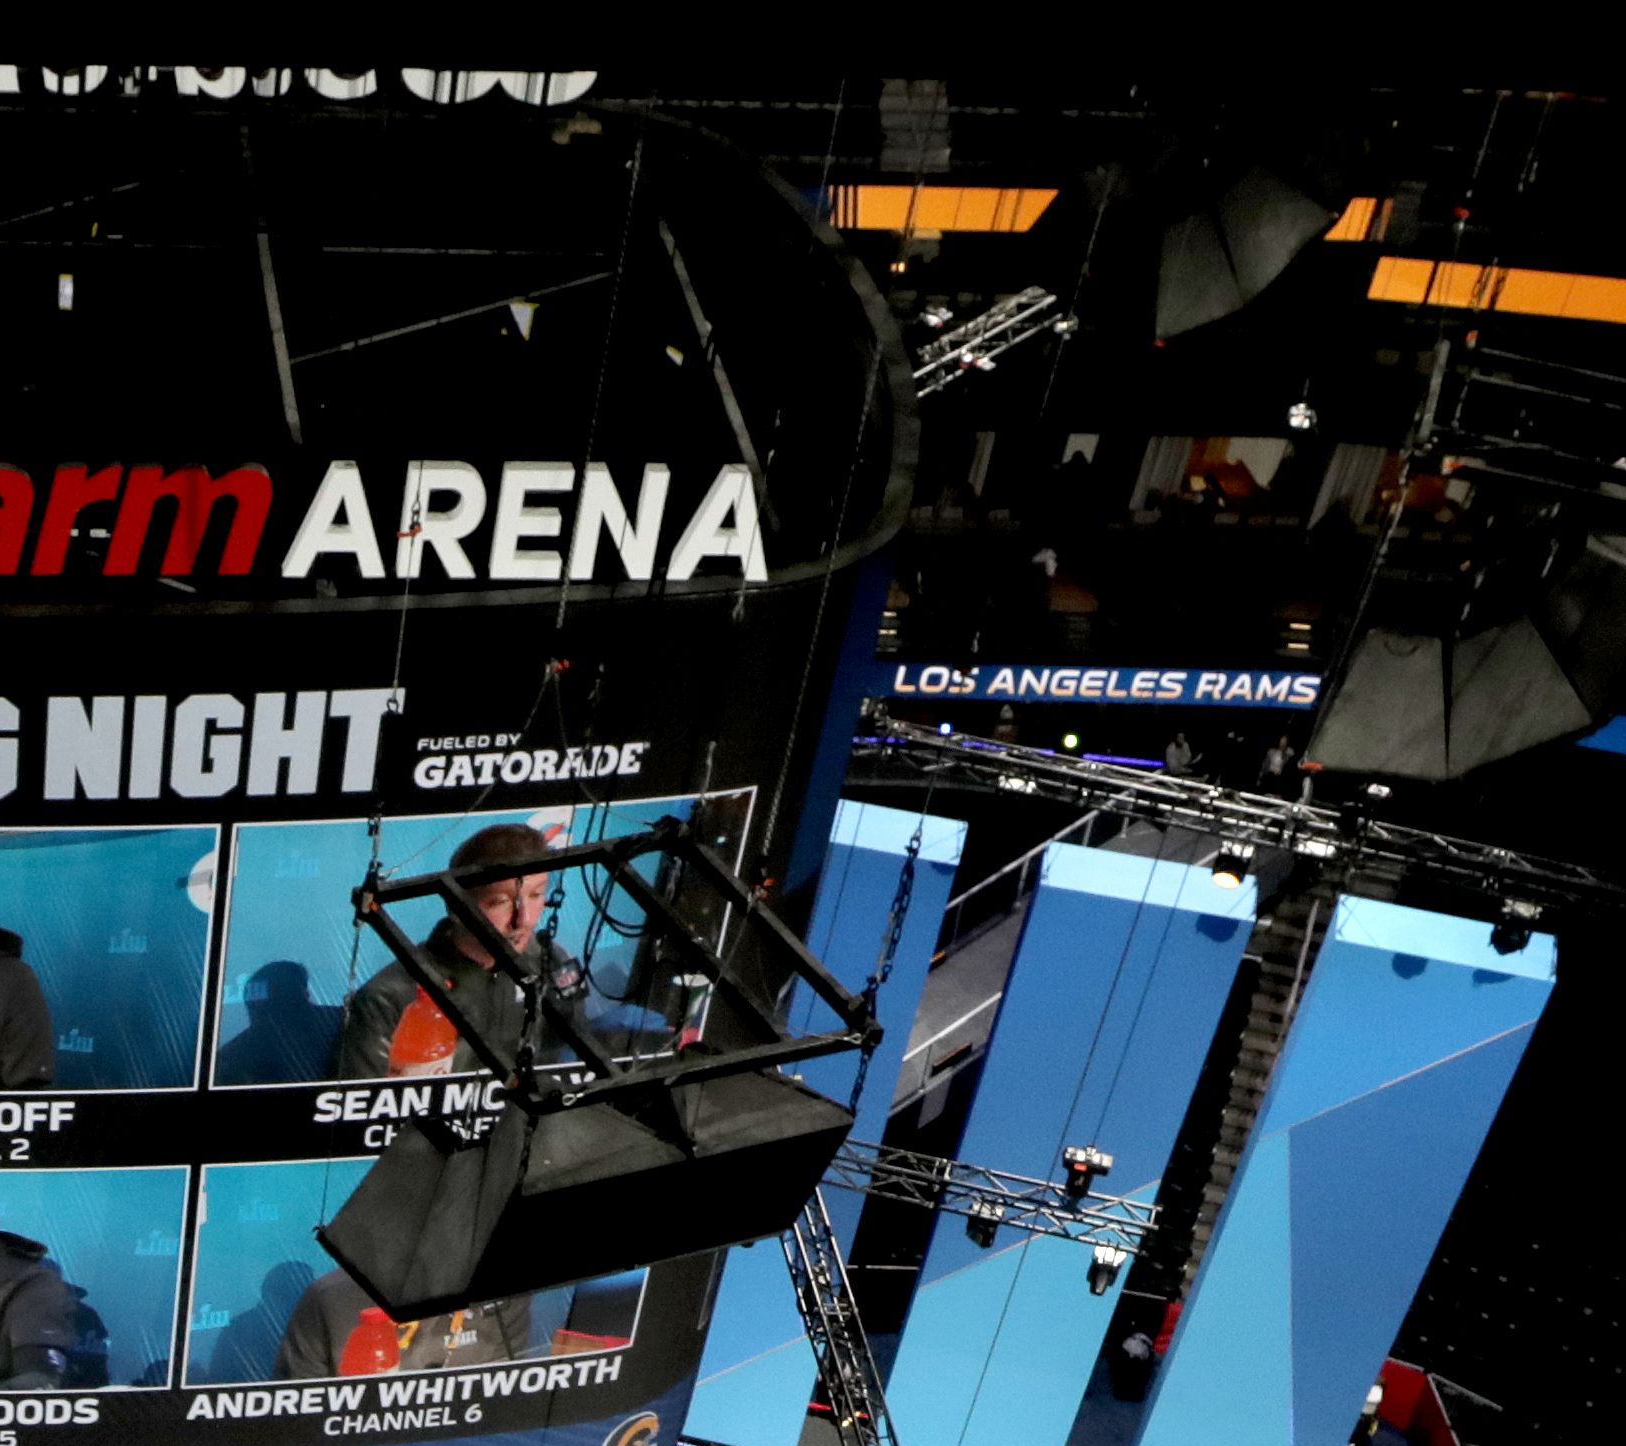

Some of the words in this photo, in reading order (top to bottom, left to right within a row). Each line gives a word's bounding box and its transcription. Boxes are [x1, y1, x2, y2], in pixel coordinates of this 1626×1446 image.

[281, 461, 770, 582] ARENA
[894, 664, 977, 694] LOS
[986, 666, 1184, 699] ANGELES
[1193, 671, 1321, 704] RAMS
[44, 688, 405, 800] NIGHT
[417, 734, 491, 751] FUELED
[495, 732, 521, 748] BY
[414, 742, 644, 789] GATORADE
[313, 1087, 432, 1123] SEAN
[9, 1139, 31, 1162] 2
[187, 1385, 369, 1421] ANDREW
[377, 1355, 624, 1409] WHITWORTH
[323, 1403, 458, 1436] CHANNEL
[464, 1402, 484, 1424] 6
